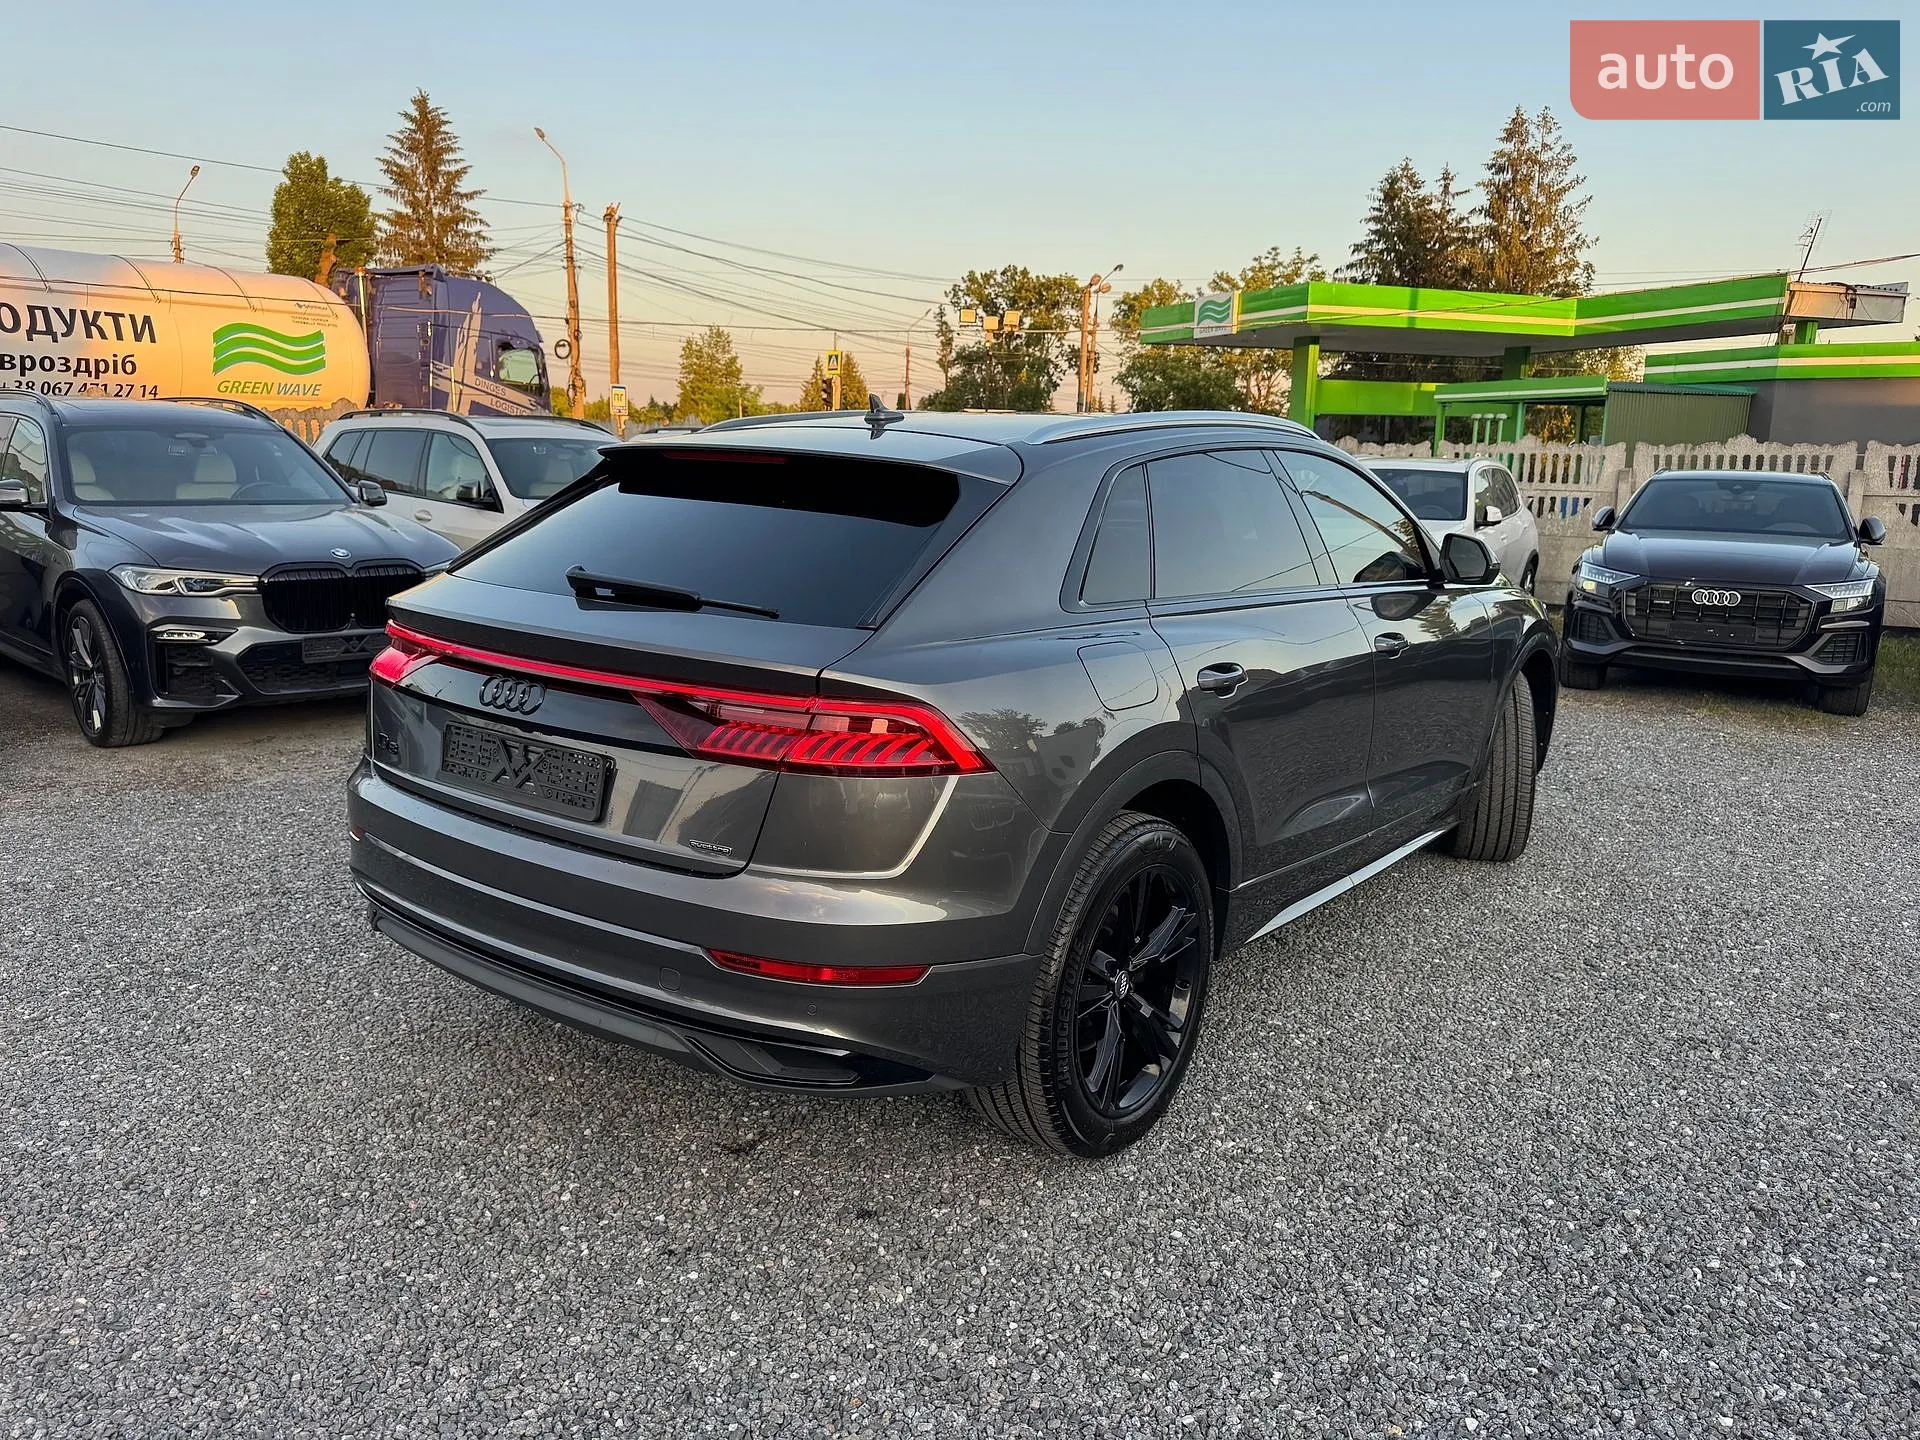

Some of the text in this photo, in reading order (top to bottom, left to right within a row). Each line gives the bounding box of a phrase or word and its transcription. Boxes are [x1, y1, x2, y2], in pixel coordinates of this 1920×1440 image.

[0, 302, 156, 343] ОДУКТИ
[0, 354, 137, 379] вроздріб
[40, 381, 74, 396] 067
[113, 383, 135, 398] 27
[140, 385, 159, 398] 14
[217, 380, 322, 397] GREEN WAVE
